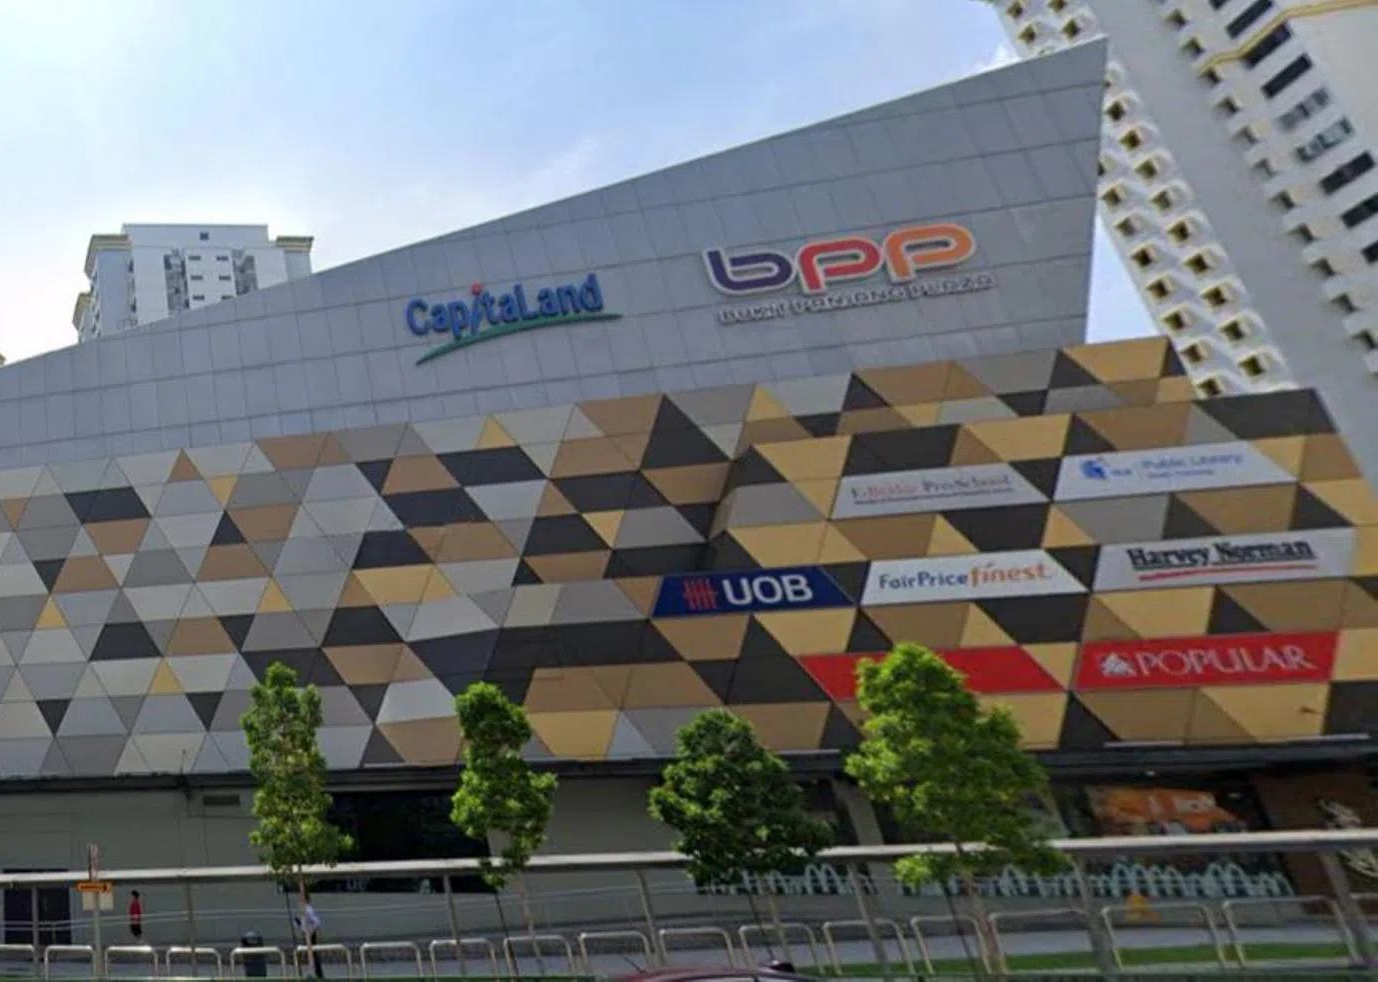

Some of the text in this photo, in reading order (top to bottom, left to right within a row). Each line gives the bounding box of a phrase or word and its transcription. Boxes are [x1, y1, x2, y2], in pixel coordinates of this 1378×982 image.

[406, 273, 605, 341] CapitaLand
[1126, 540, 1318, 571] Harvey Norman
[722, 573, 814, 606] UOB
[878, 560, 1049, 590] FairPrice finest
[1135, 644, 1319, 677] POPULAR
